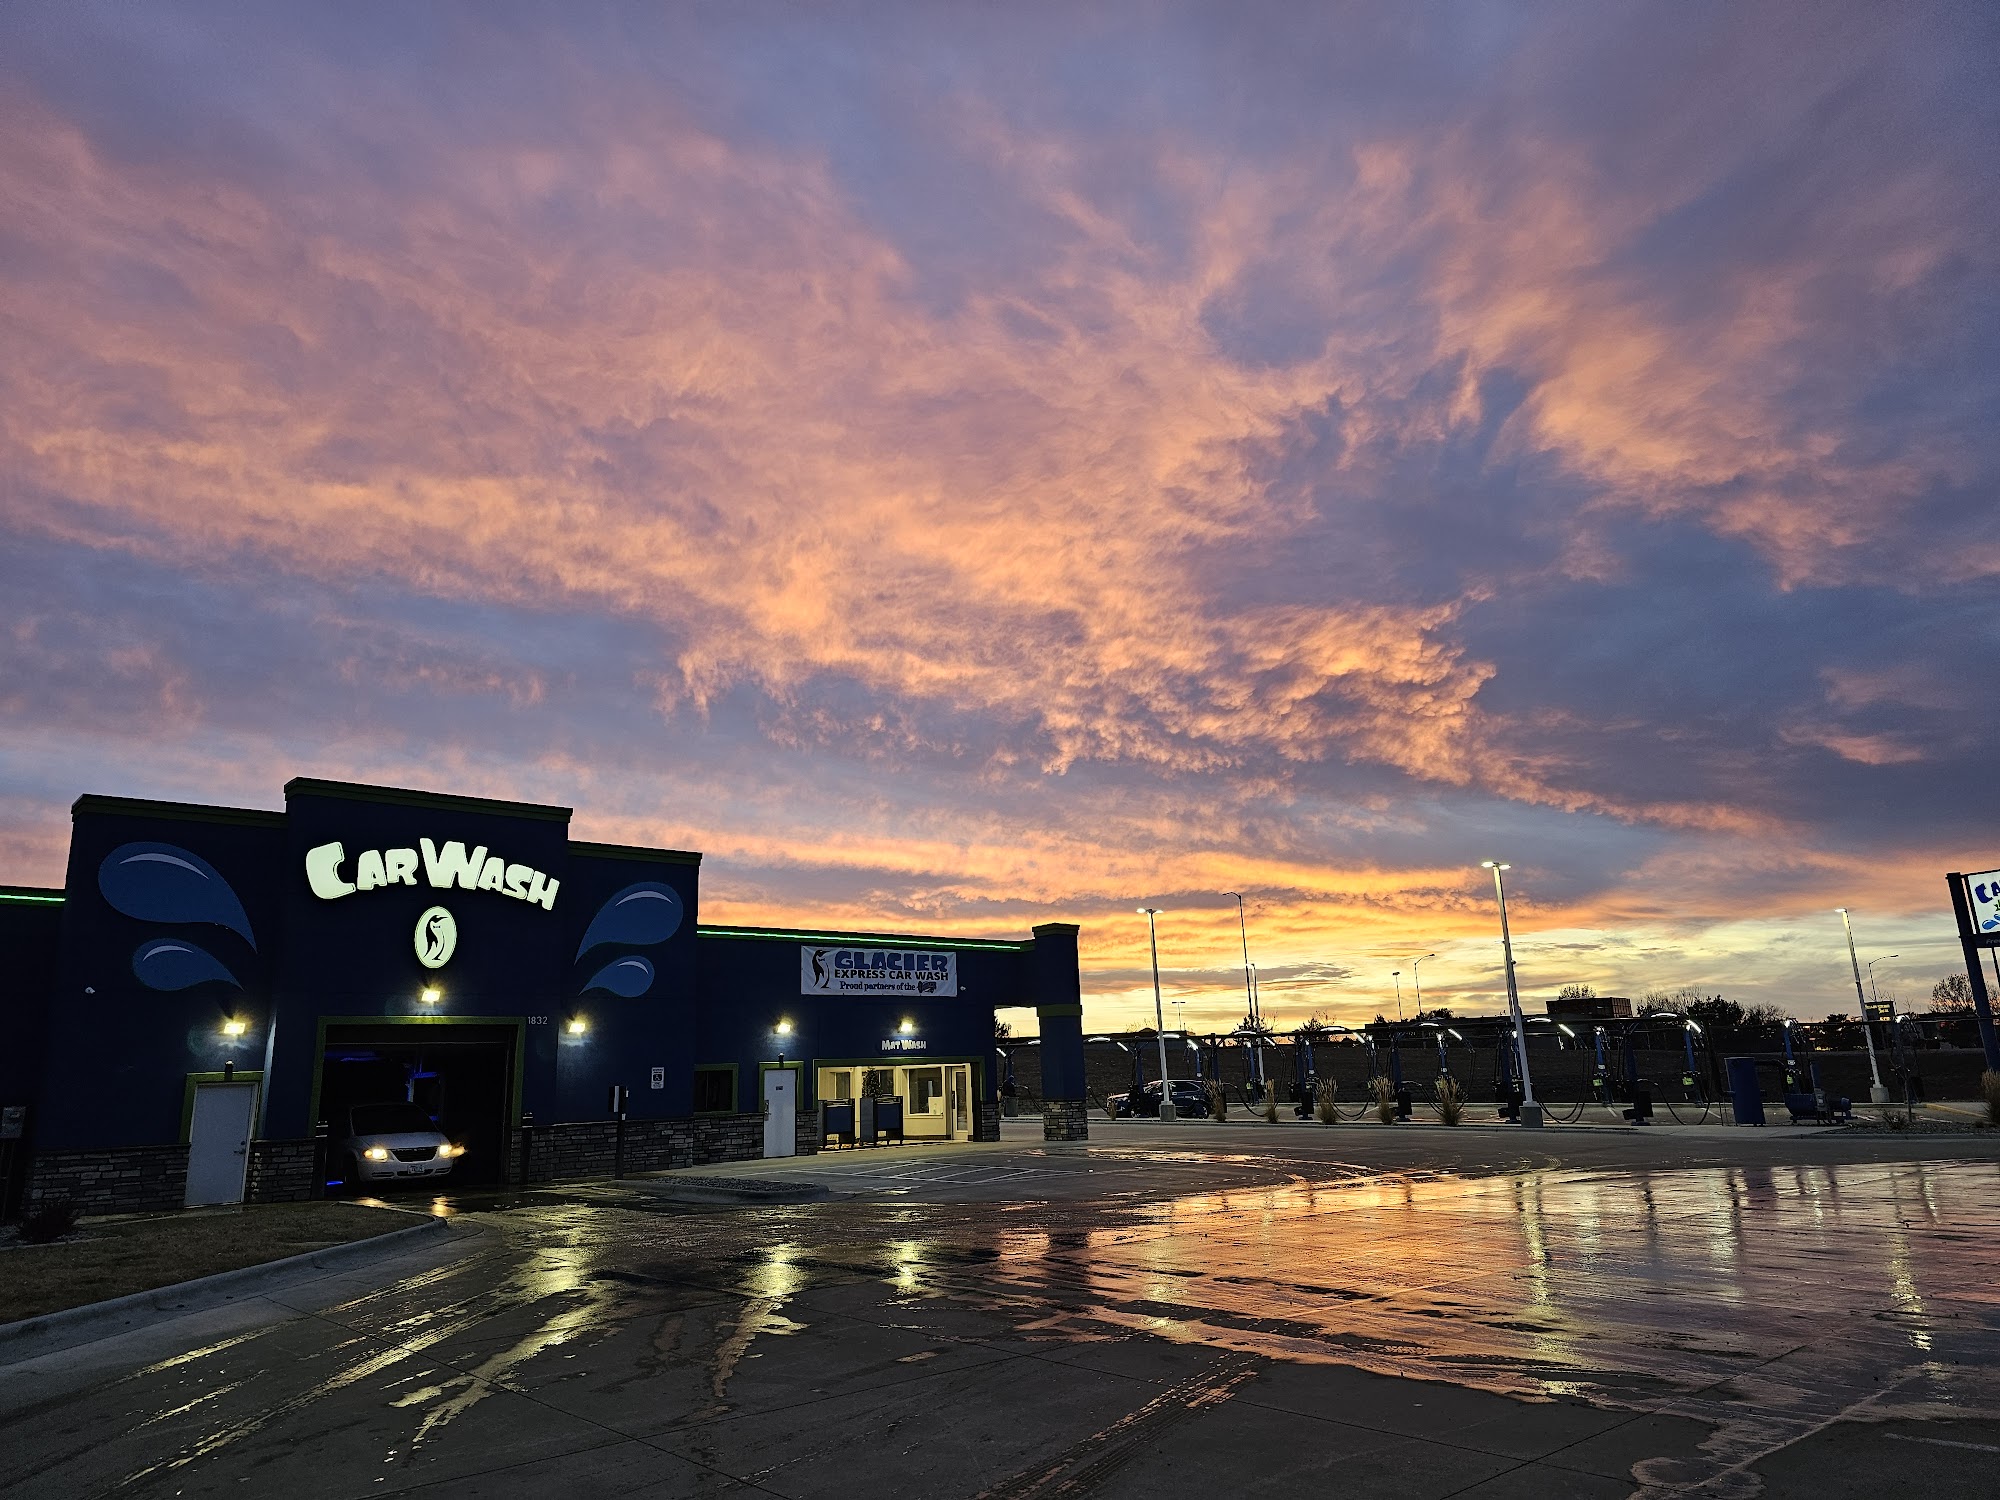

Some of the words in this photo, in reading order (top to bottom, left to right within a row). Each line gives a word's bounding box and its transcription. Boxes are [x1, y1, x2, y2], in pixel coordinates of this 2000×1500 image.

[305, 841, 418, 900] CAR
[419, 837, 560, 911] WASH
[834, 950, 948, 972] GLACIER
[834, 969, 886, 979] EXPRESS
[889, 970, 912, 980] CAR
[915, 971, 949, 981] WASH
[839, 981, 863, 990] Proud
[864, 981, 895, 991] partners
[896, 982, 906, 991] of
[905, 982, 916, 991] the
[528, 1016, 548, 1025] 1832
